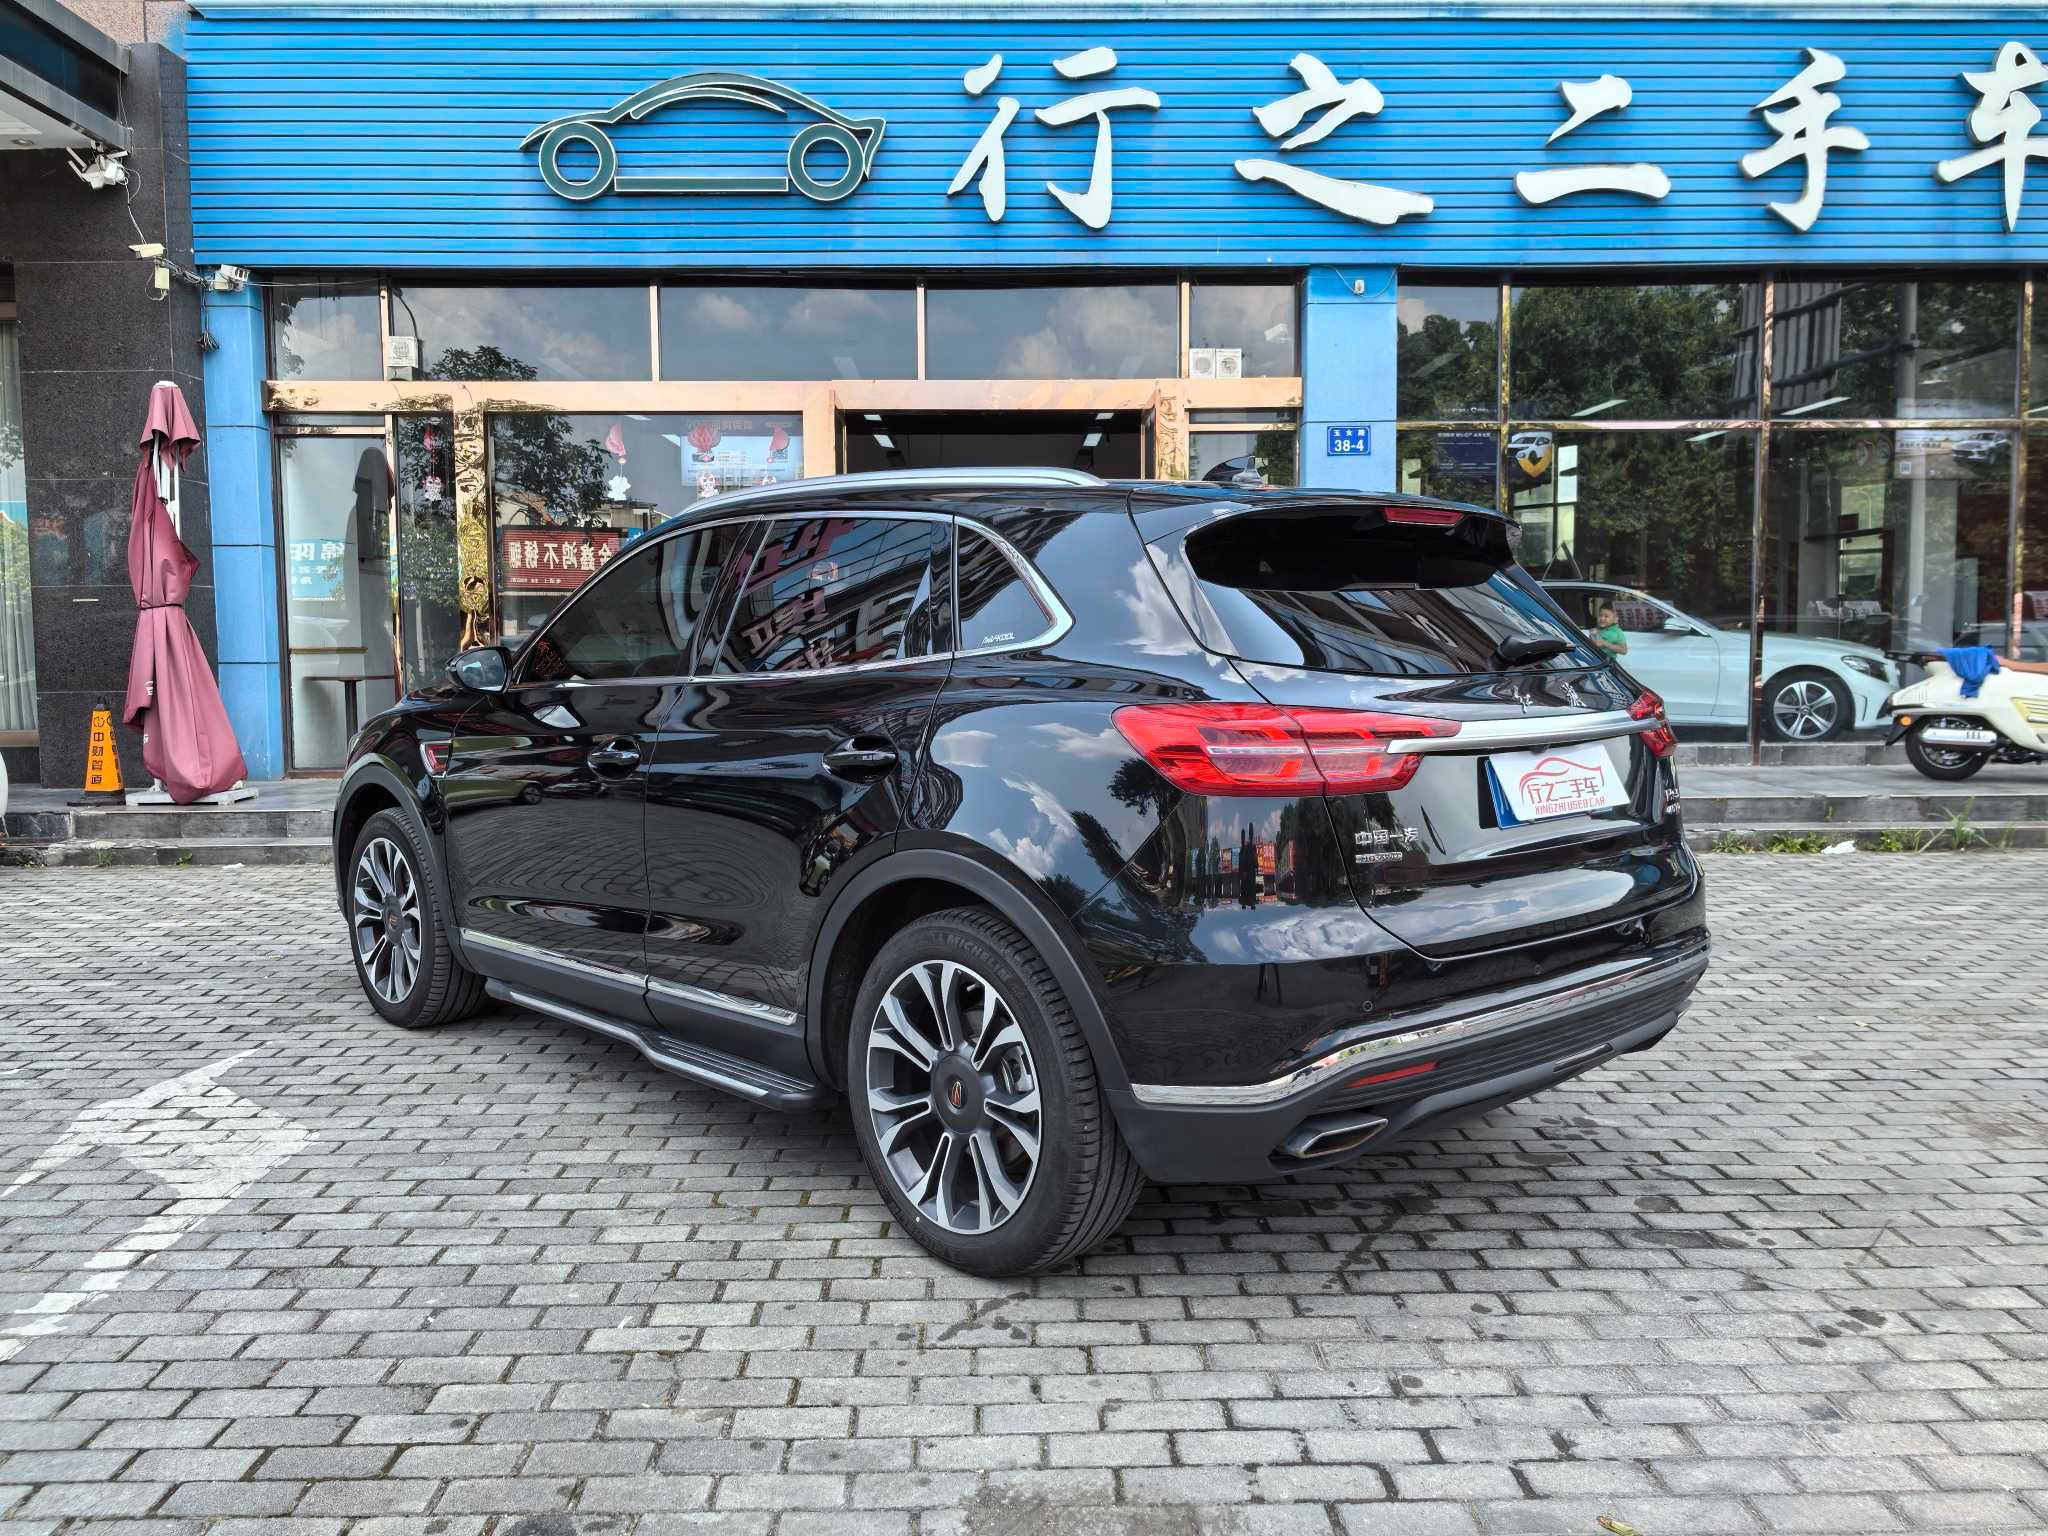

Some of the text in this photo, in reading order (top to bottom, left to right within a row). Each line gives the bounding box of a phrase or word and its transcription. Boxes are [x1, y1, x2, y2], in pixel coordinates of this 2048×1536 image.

[949, 41, 2048, 233] 行之二手车
[1334, 439, 1364, 452] 38-4
[1526, 776, 1601, 805] 行之二手车
[1567, 798, 1589, 811] USED
[1589, 796, 1605, 808] CAR
